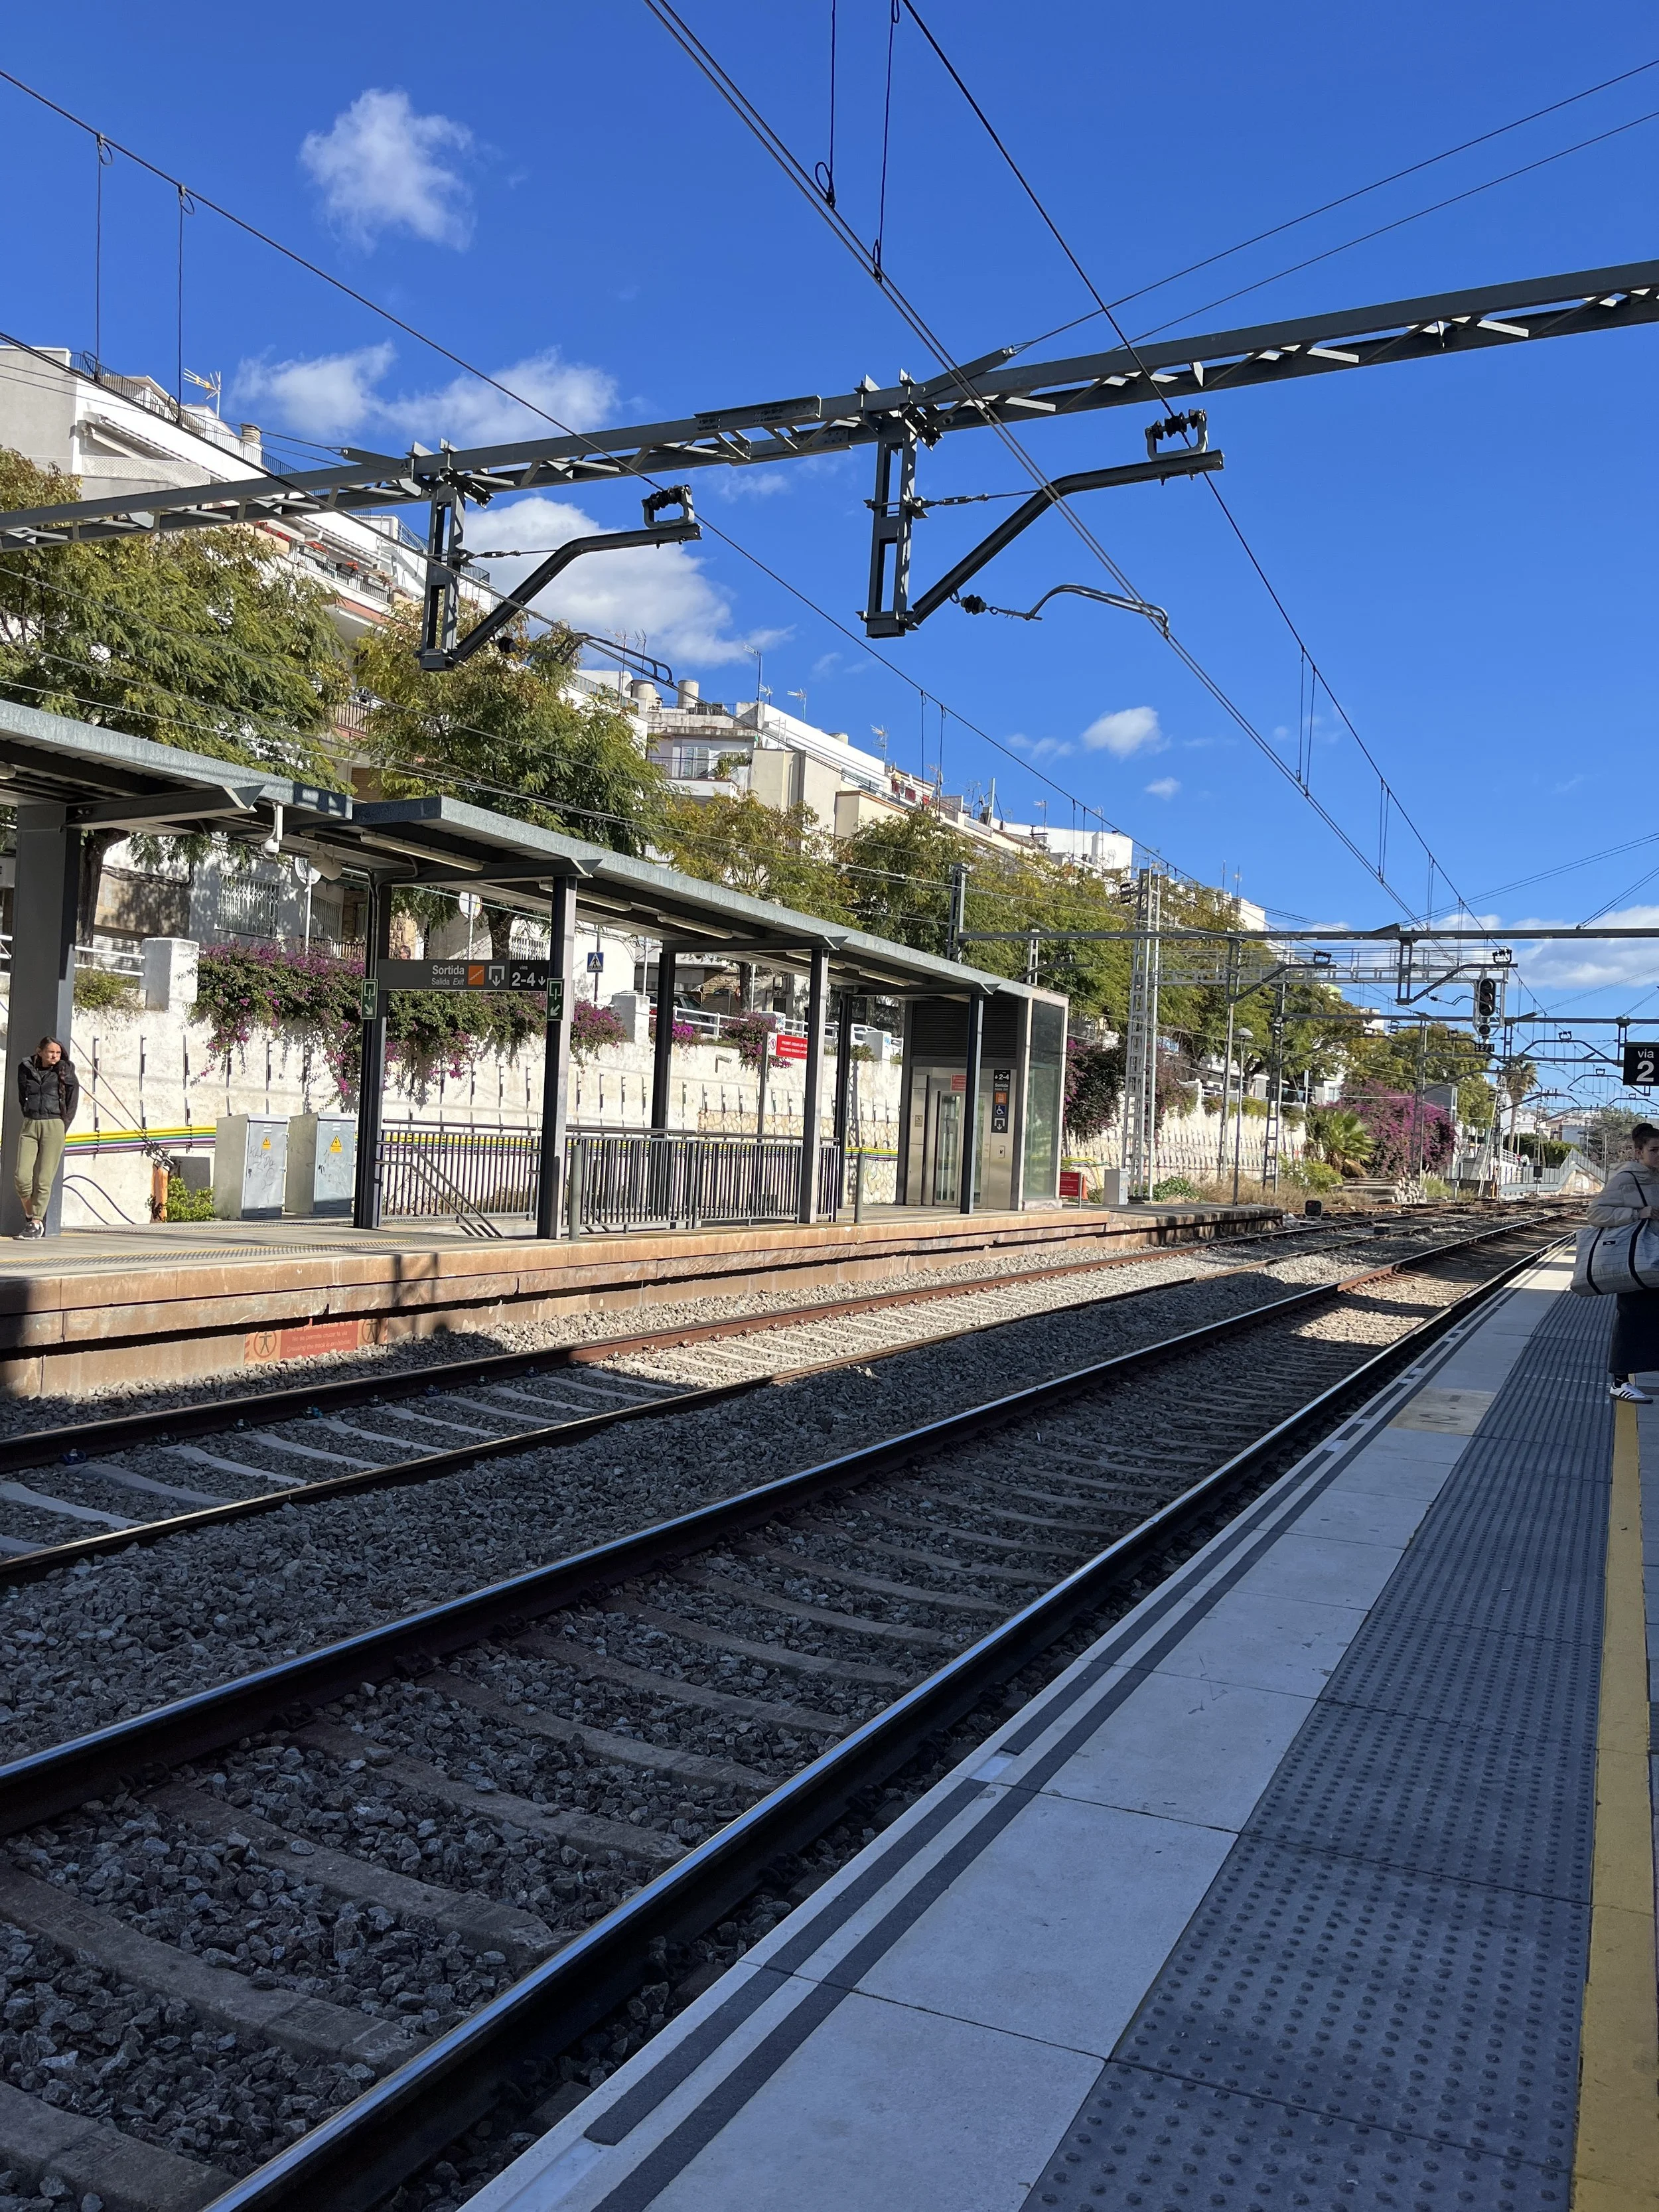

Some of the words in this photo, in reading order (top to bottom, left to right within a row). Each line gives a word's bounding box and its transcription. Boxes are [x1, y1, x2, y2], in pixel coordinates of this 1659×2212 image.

[432, 965, 465, 975] Sortida
[512, 972, 536, 987] 2-4
[1636, 1061, 1654, 1082] 2
